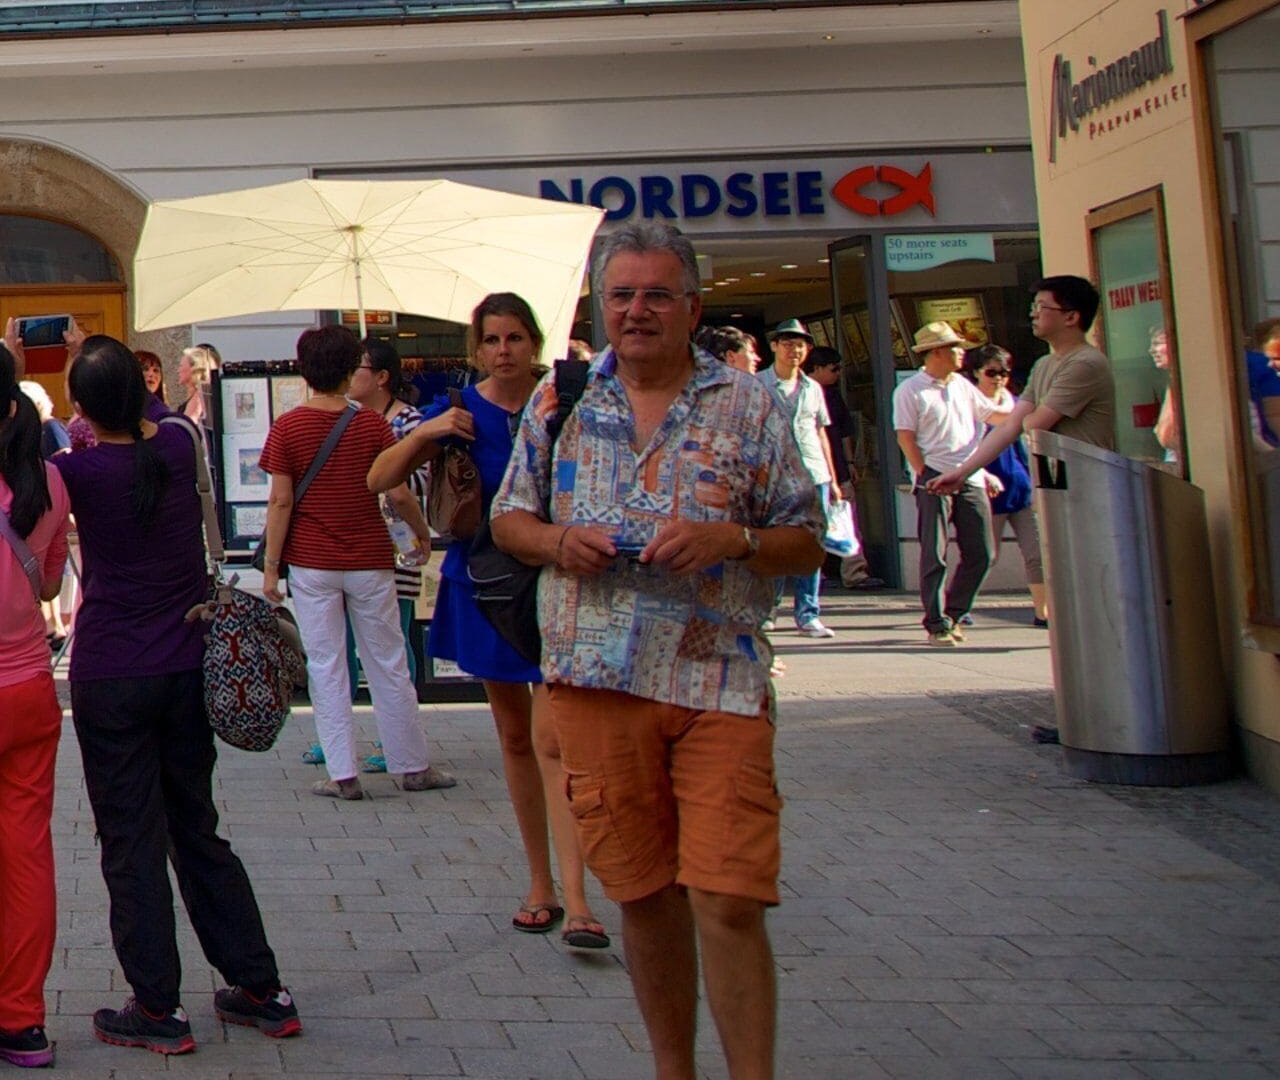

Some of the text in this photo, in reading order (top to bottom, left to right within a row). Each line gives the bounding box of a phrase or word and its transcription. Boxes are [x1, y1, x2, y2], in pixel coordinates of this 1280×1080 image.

[1049, 8, 1174, 163] Marionnaud
[539, 170, 826, 221] NORDSEE
[888, 237, 968, 249] 50 more seats
[889, 249, 934, 263] upstairs
